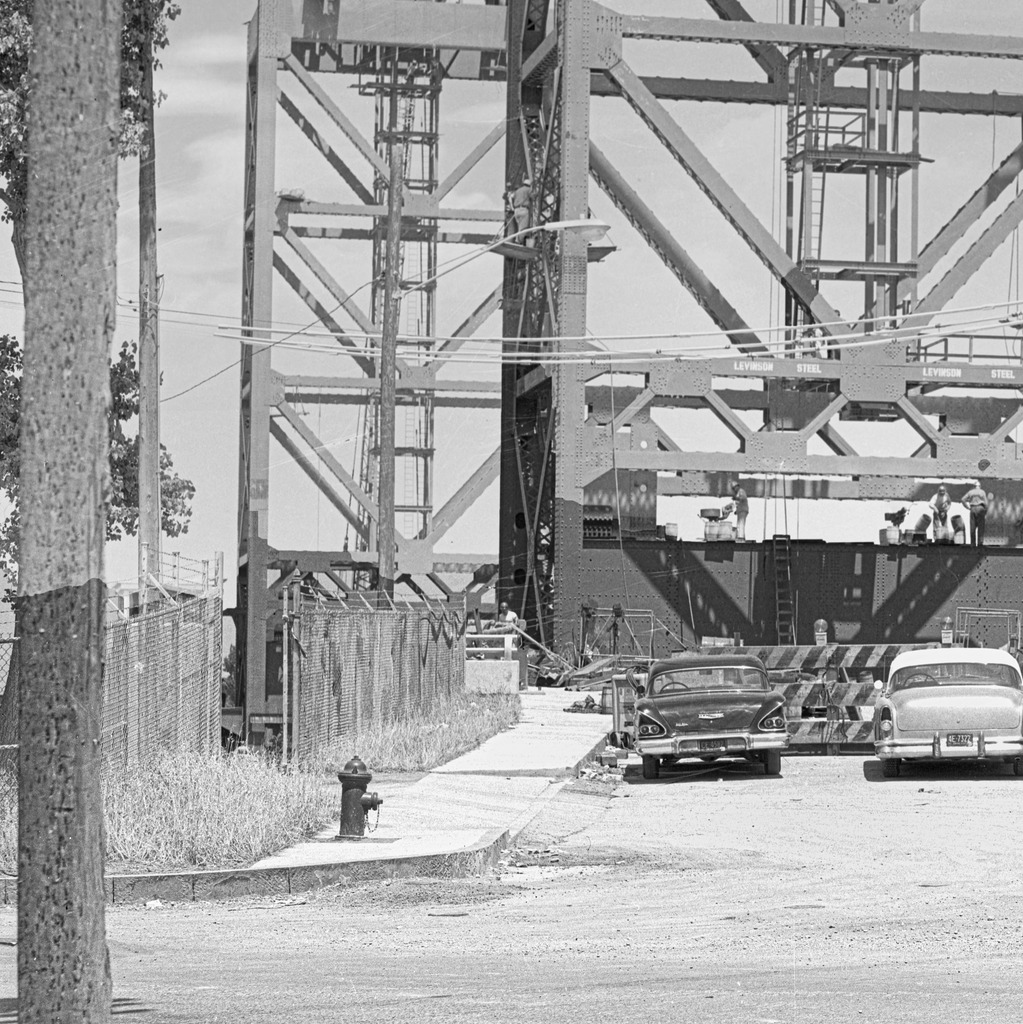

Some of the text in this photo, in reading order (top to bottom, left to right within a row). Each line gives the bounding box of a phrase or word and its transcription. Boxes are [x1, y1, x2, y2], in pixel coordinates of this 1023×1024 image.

[733, 360, 822, 373] LEVINSON STEEL
[922, 366, 1016, 379] LEVINSON STEEL
